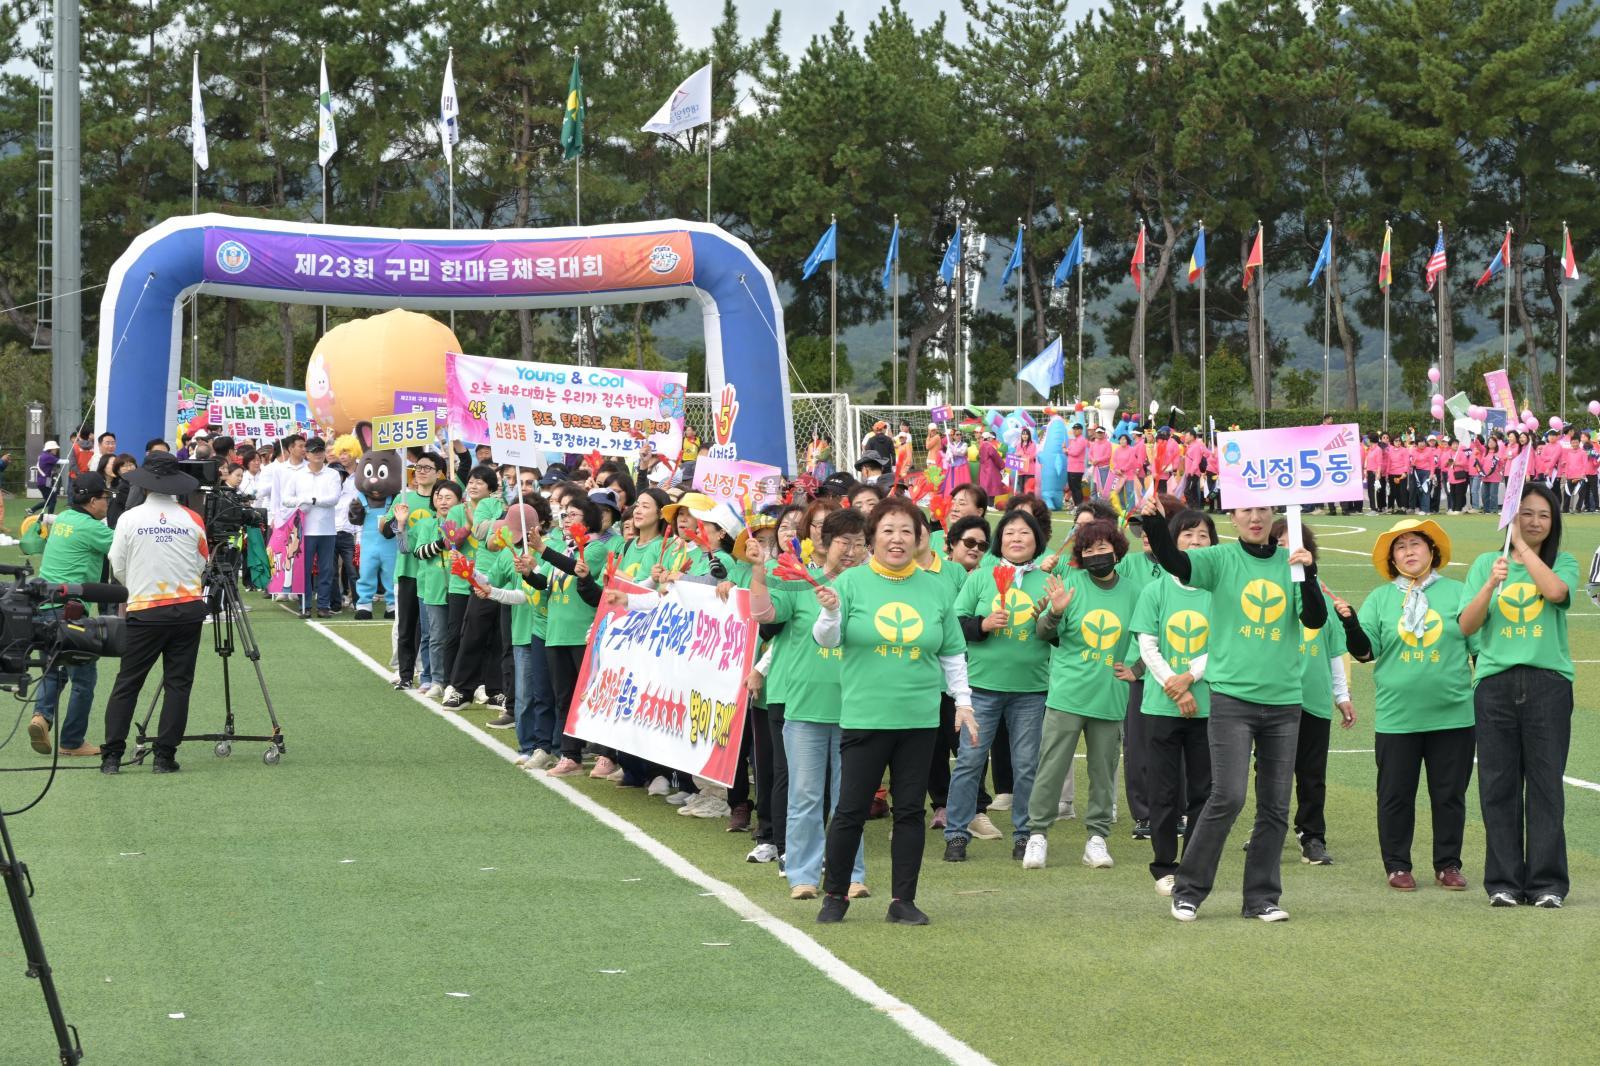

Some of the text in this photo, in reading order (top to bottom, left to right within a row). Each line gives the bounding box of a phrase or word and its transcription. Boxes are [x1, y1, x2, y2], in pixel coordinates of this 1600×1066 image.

[294, 253, 603, 282] 제23회 구민 한마음체육대회
[516, 367, 624, 388] Young & Cool
[562, 389, 598, 404] 우리가
[224, 405, 291, 420] 나눔과 힐링의
[720, 405, 730, 436] 5
[560, 413, 606, 430] 팀워크도,
[378, 418, 429, 444] 신정5동
[495, 422, 527, 441] 신정5동
[1241, 449, 1353, 489] 신정5동
[703, 472, 766, 502] 신정5동
[137, 527, 189, 535] GYEONGNAM
[155, 535, 173, 543] 2025
[1239, 624, 1281, 641] 새마을
[1500, 625, 1544, 639] 새마을
[874, 644, 921, 660] 새마을
[1081, 649, 1114, 666] 새마을
[1400, 650, 1440, 663] 새마을
